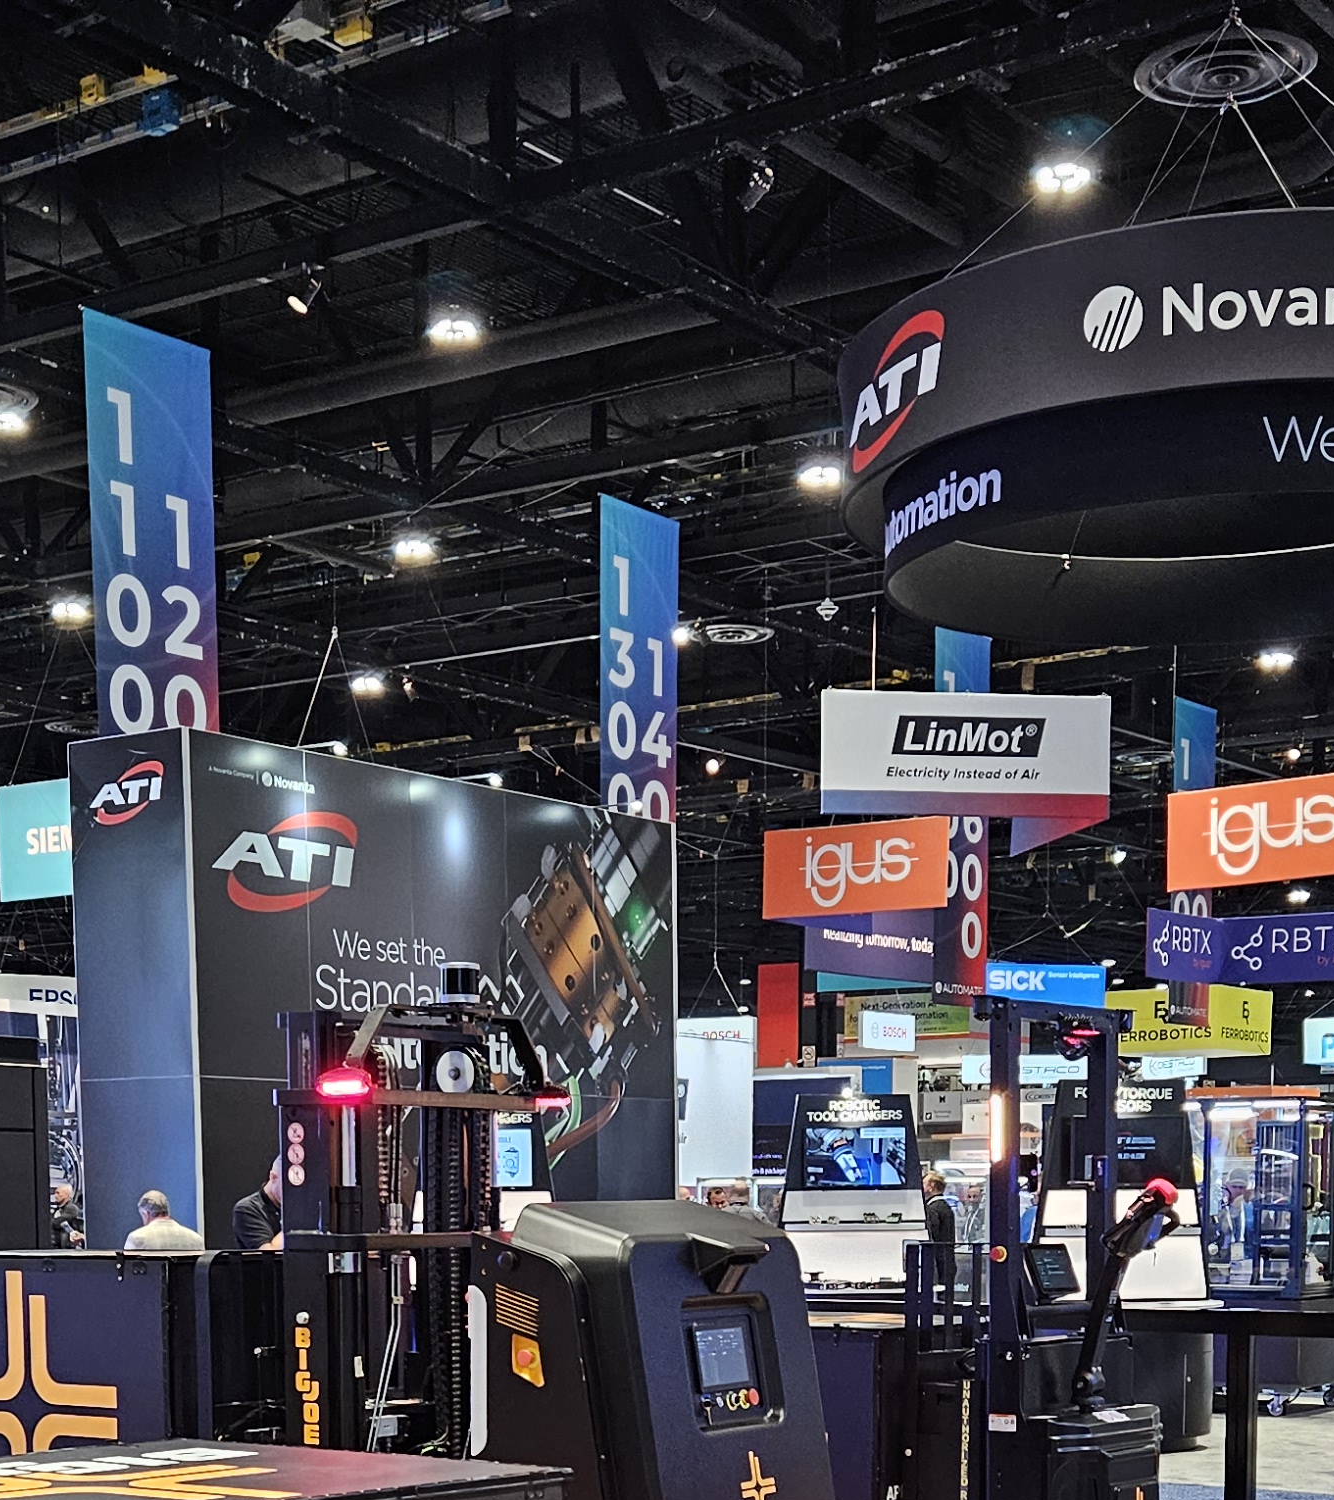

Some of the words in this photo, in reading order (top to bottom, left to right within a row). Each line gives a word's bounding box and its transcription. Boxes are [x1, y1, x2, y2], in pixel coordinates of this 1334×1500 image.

[850, 342, 942, 449] ATI
[886, 766, 951, 781] Electricity
[954, 767, 1000, 780] Instead
[1004, 768, 1019, 781] of
[1020, 768, 1041, 780] Air
[90, 777, 163, 808] ATI
[274, 775, 316, 794] Novanta
[212, 830, 355, 888] ATI
[804, 836, 912, 909] igus
[333, 928, 371, 961] We
[376, 937, 407, 965] set
[413, 938, 446, 967] the
[1172, 926, 1212, 955] RBTX
[1318, 955, 1330, 965] by
[989, 969, 1046, 991] SICK
[883, 1026, 907, 1039] BOSCH
[1121, 1026, 1212, 1042] ERROBOTICS
[1221, 1026, 1269, 1043] FERROBOTICS
[829, 1099, 880, 1111] ROBOTIC
[807, 1110, 838, 1123] TOOL
